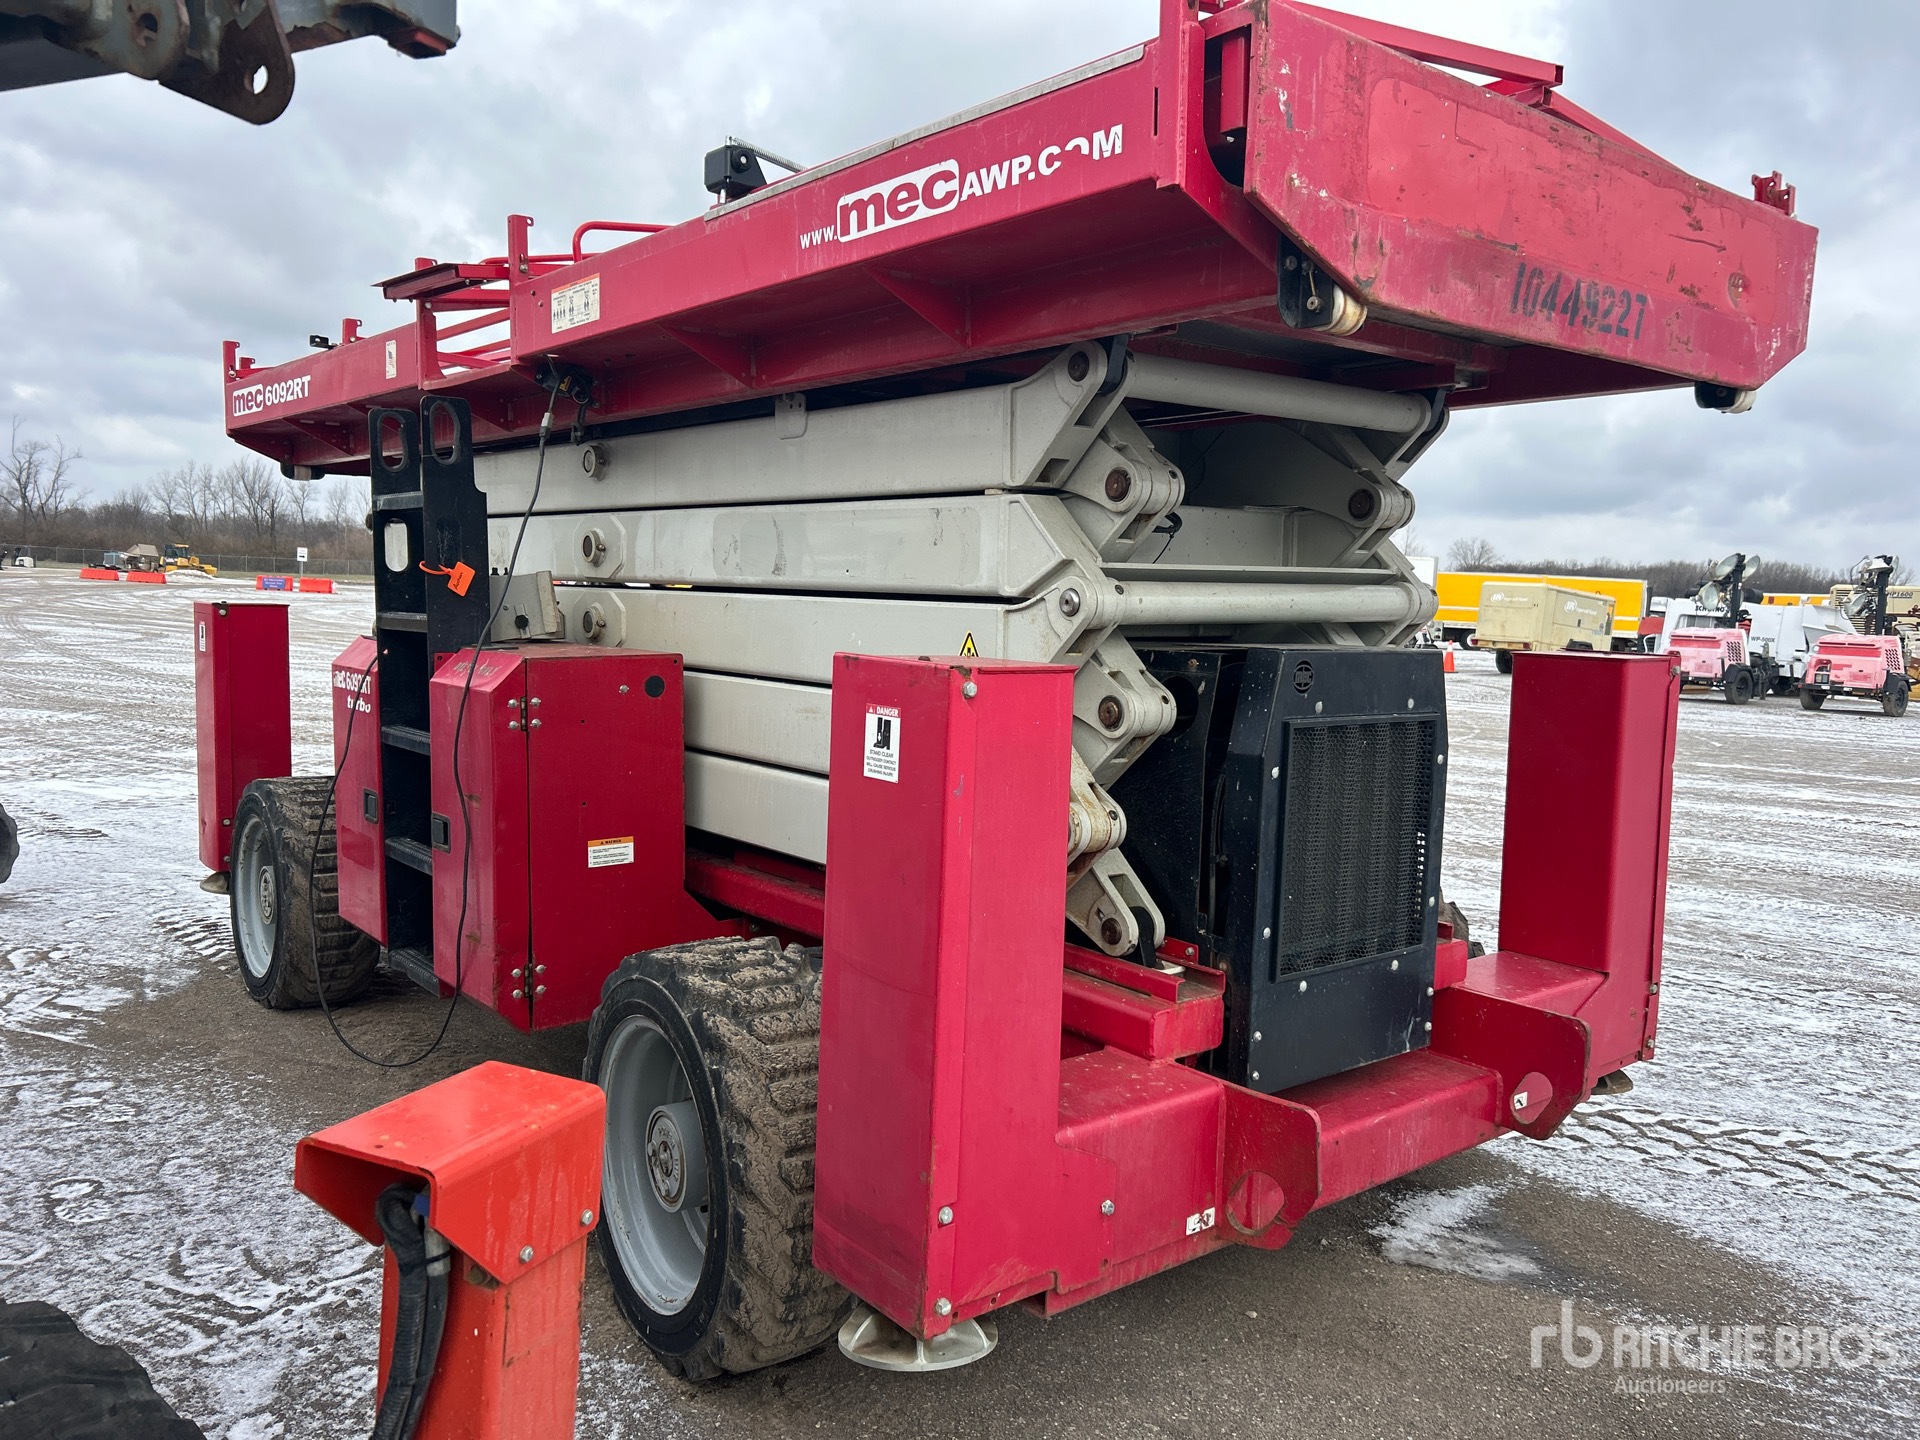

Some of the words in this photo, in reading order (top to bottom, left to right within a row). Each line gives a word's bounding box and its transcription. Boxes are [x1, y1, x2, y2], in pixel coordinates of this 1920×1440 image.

[233, 387, 263, 415] mec
[265, 375, 311, 406] 6092RT
[876, 706, 899, 717] DANGER
